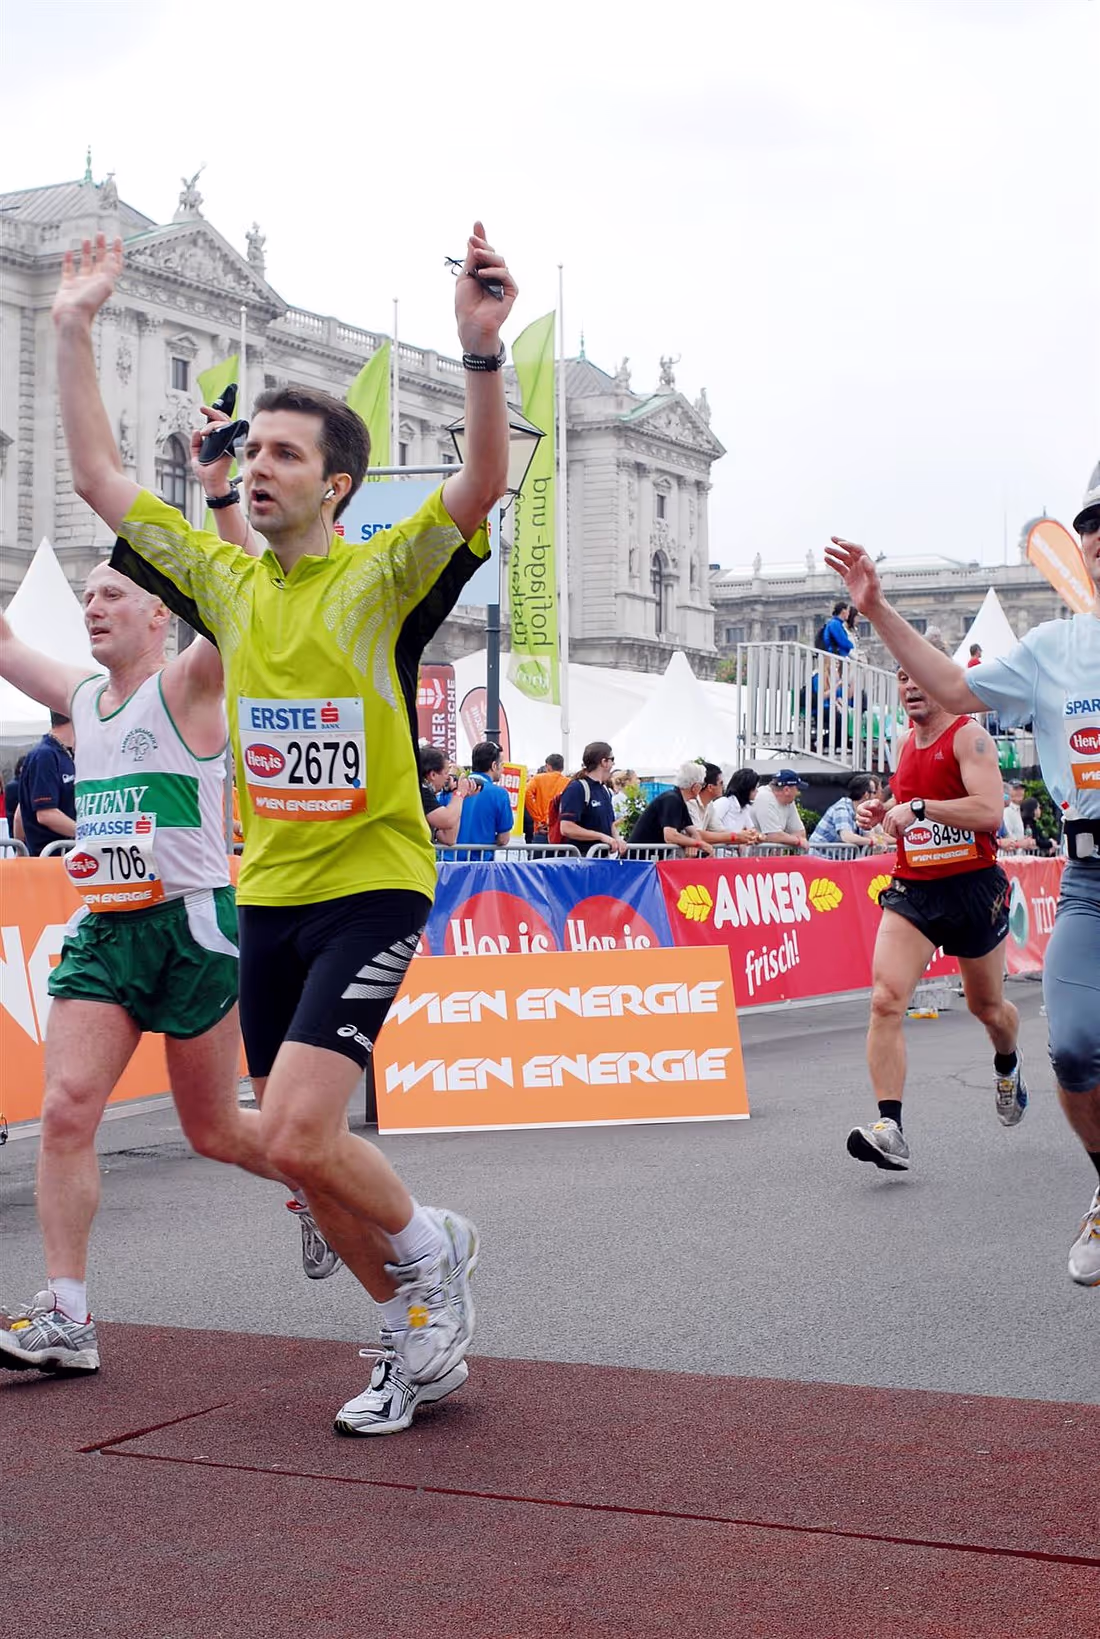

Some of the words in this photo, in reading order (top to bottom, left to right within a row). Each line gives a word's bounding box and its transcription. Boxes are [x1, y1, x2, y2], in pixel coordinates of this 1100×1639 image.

[251, 707, 317, 730] ERSTE
[247, 750, 282, 771] Hervis
[287, 741, 360, 785] 2679
[256, 796, 285, 810] WIEN
[286, 799, 353, 812] ENERGIE
[101, 845, 146, 880] 706
[101, 890, 153, 904] ENERGIE
[714, 872, 811, 929] ANKER
[745, 929, 800, 996] frisch!
[383, 990, 508, 1025] WIEN
[516, 981, 724, 1021] ENERGIE
[385, 1057, 514, 1094] WIEN
[522, 1047, 733, 1088] ENERGIE
